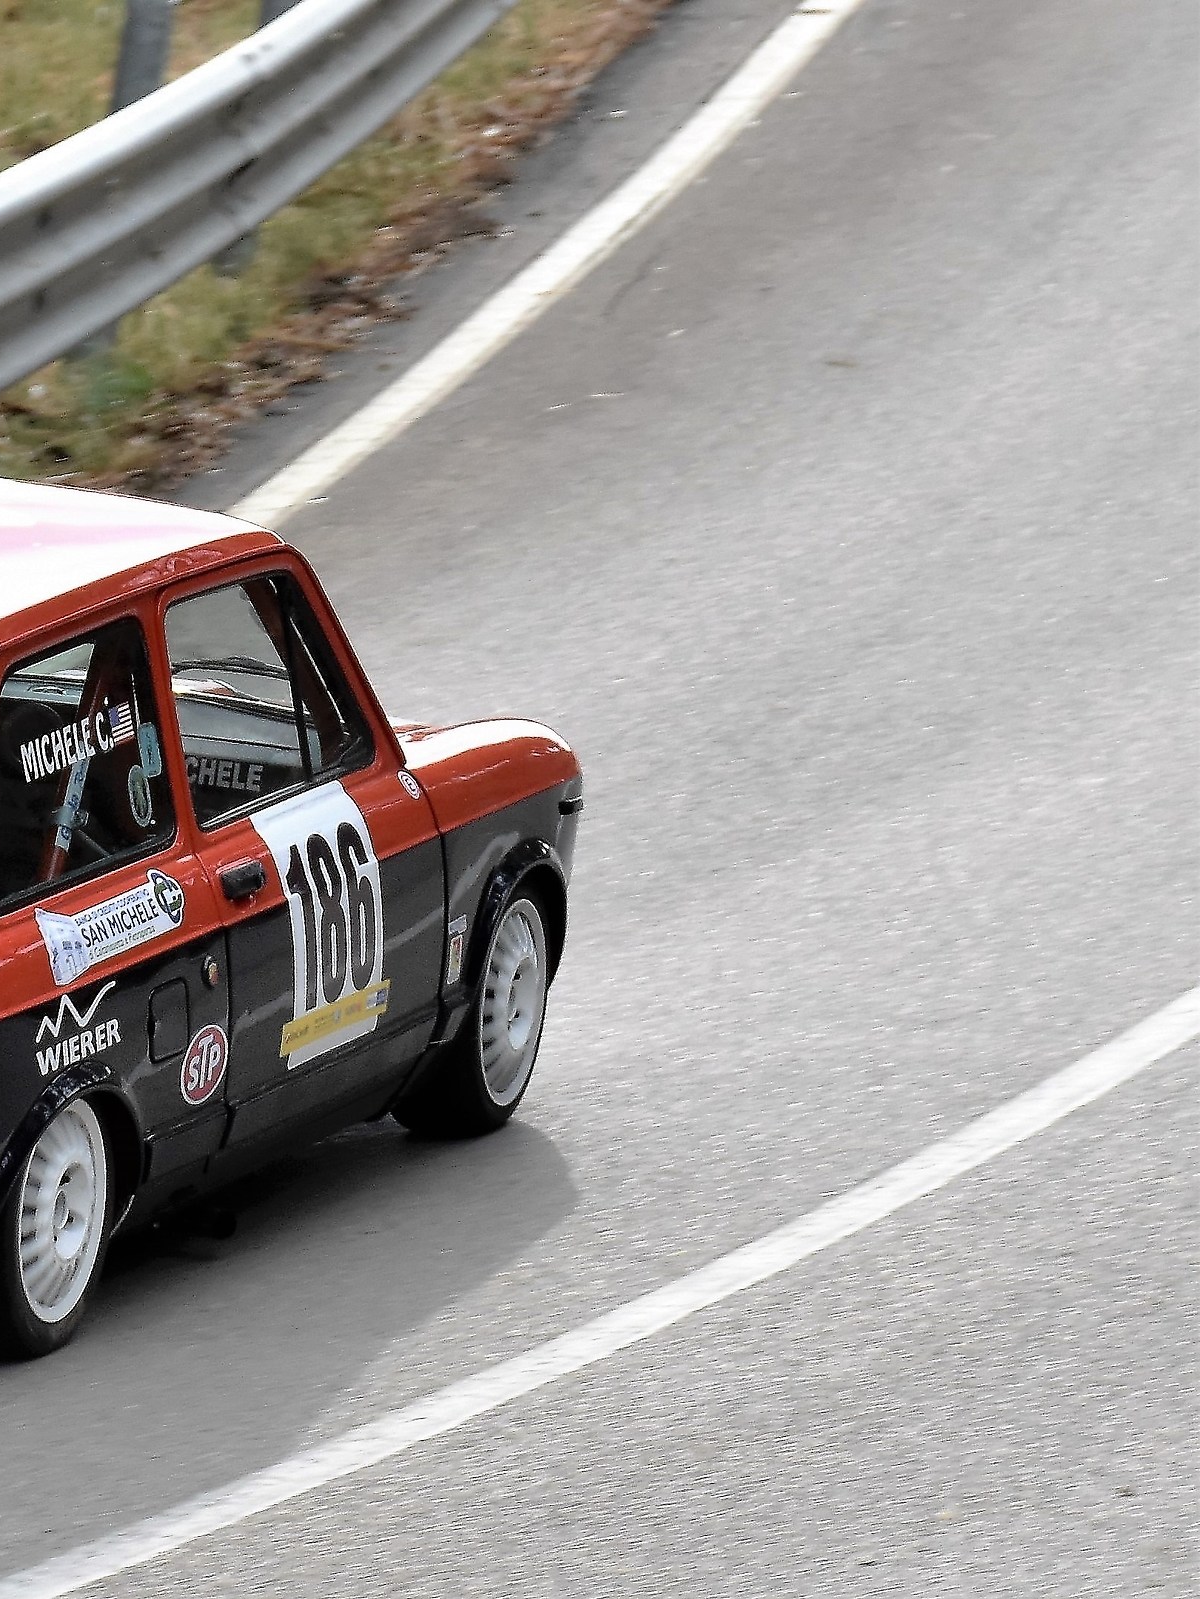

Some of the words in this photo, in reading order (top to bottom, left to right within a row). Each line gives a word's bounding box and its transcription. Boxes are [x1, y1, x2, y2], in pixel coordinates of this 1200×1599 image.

[20, 717, 96, 783] MICHELE
[95, 712, 115, 751] C.
[81, 920, 109, 948] SAN
[106, 898, 160, 937] MICHELE
[285, 821, 376, 1011] 186
[35, 1018, 122, 1076] WIERER
[187, 1033, 222, 1091] STP
